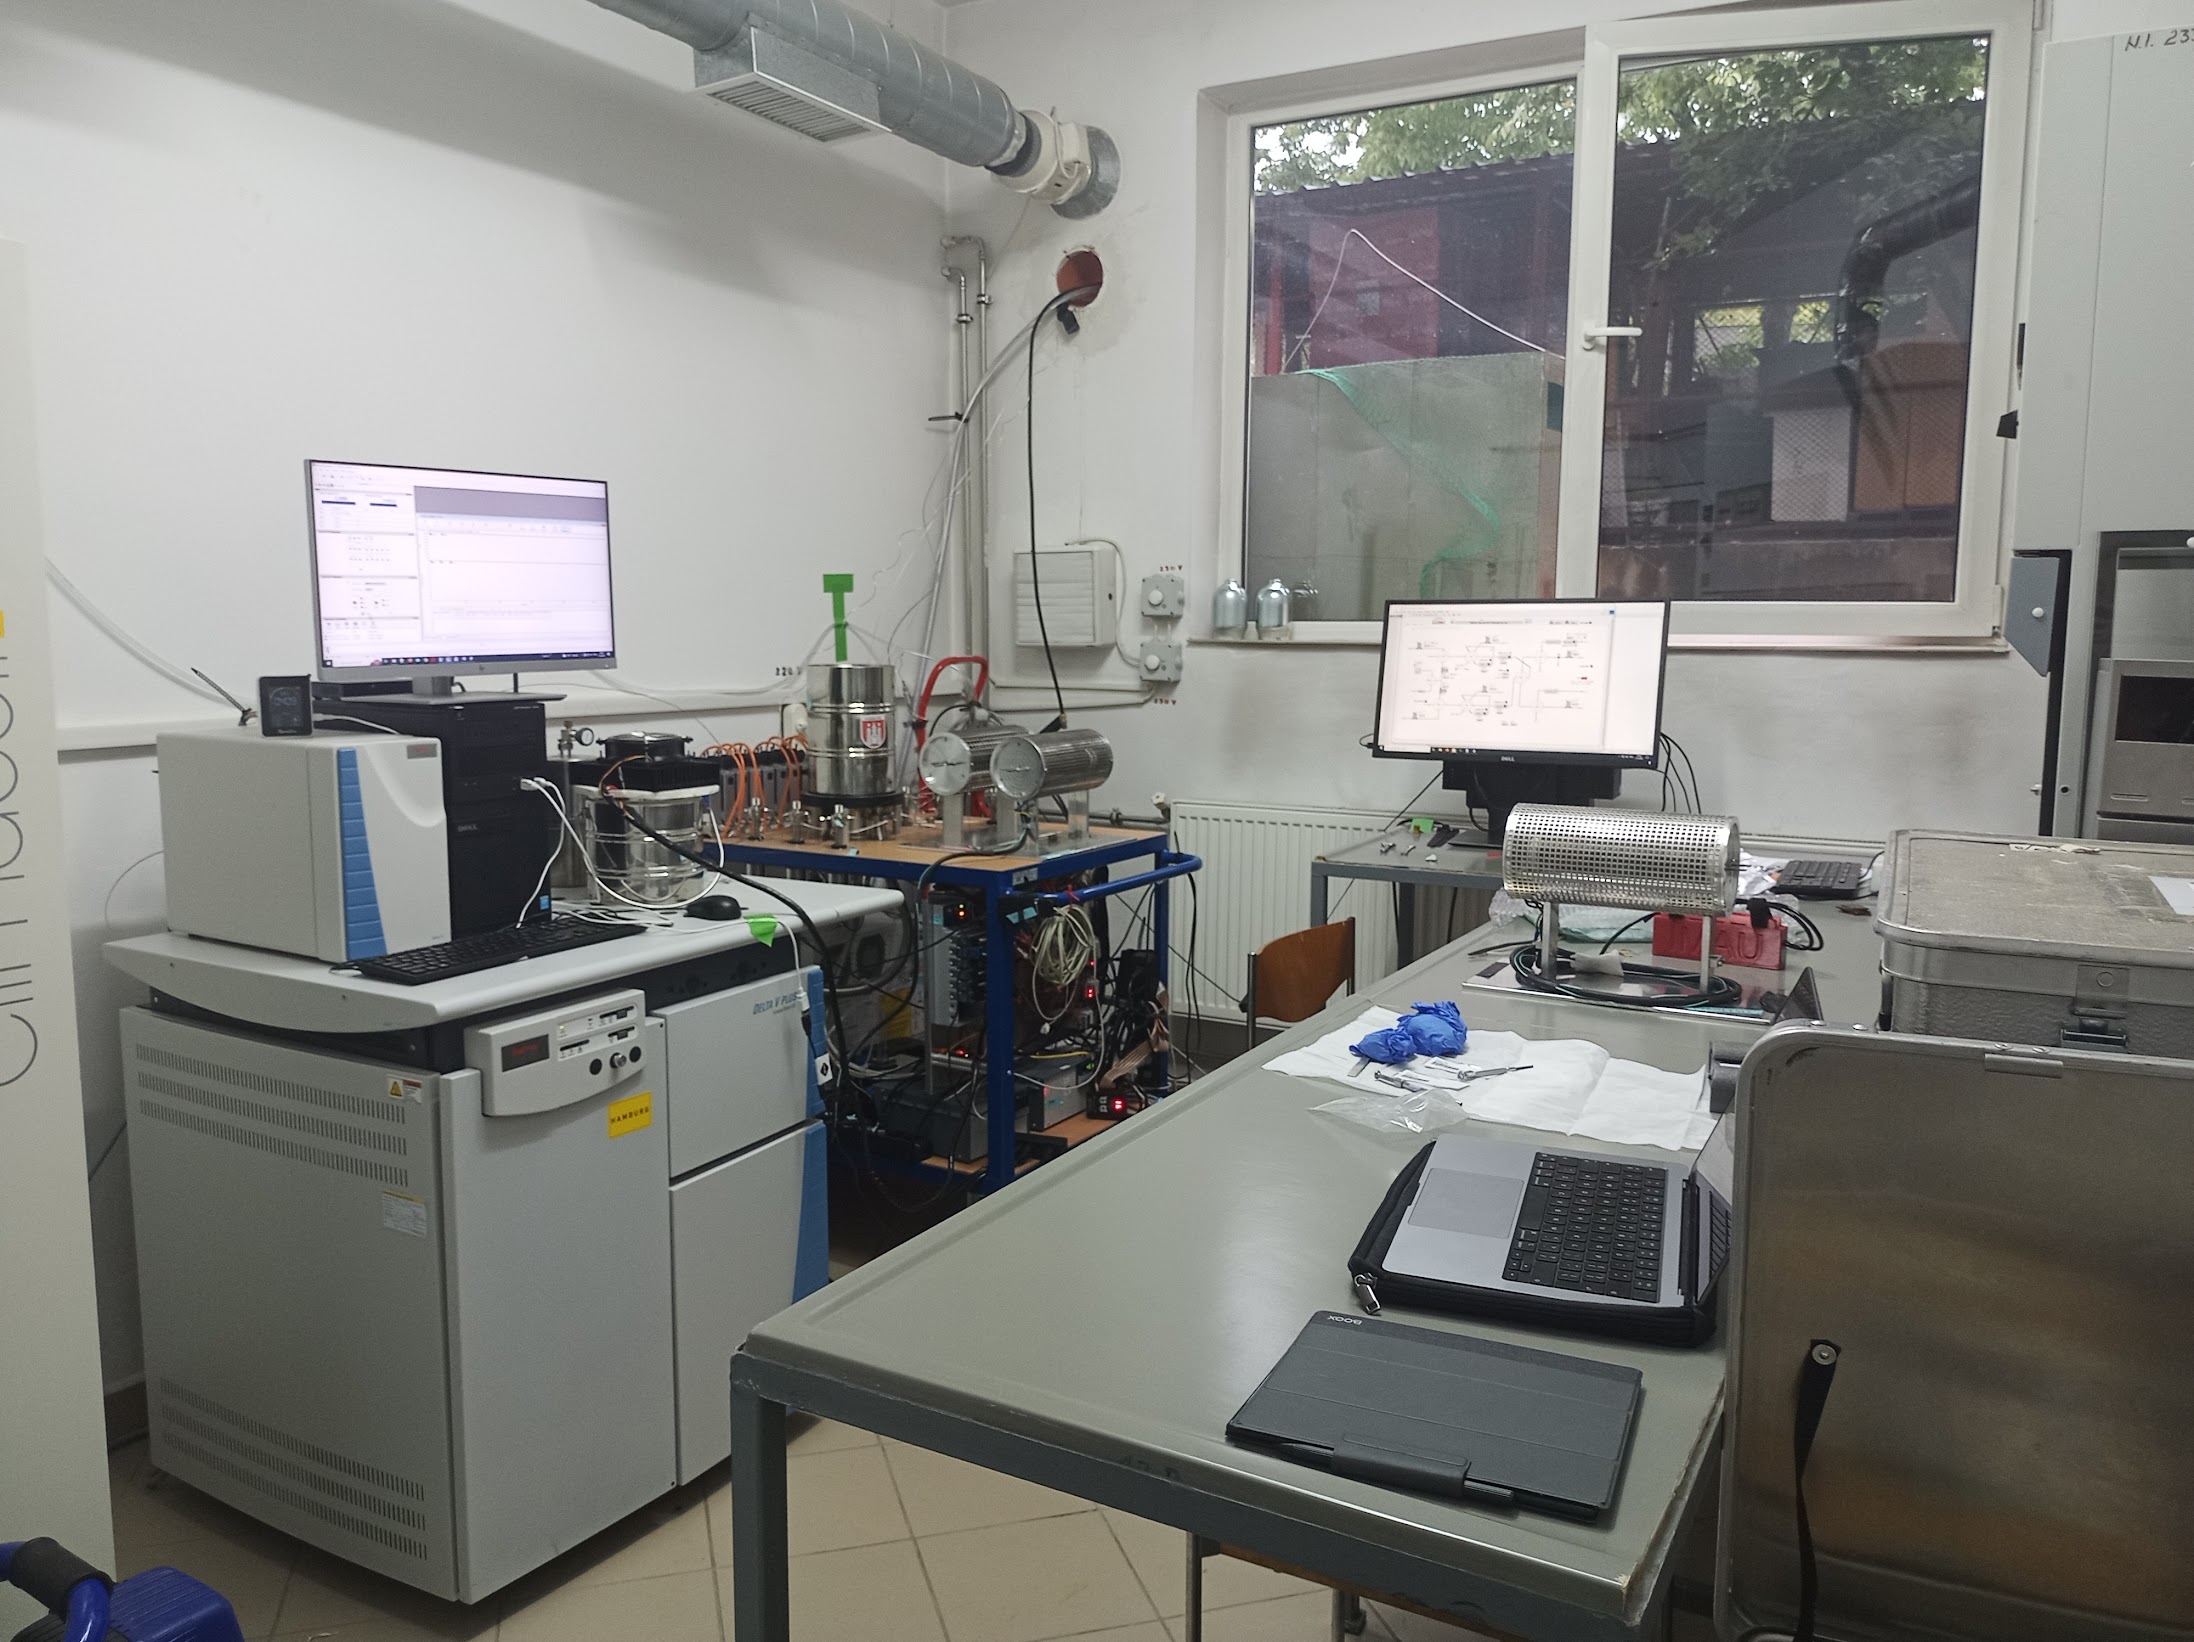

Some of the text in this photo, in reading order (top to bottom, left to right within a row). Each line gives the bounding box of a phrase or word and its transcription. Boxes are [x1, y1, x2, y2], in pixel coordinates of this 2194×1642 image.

[457, 823, 478, 832] DELL
[610, 1106, 649, 1124] HAMBURG
[1327, 1315, 1363, 1326] BOOX
